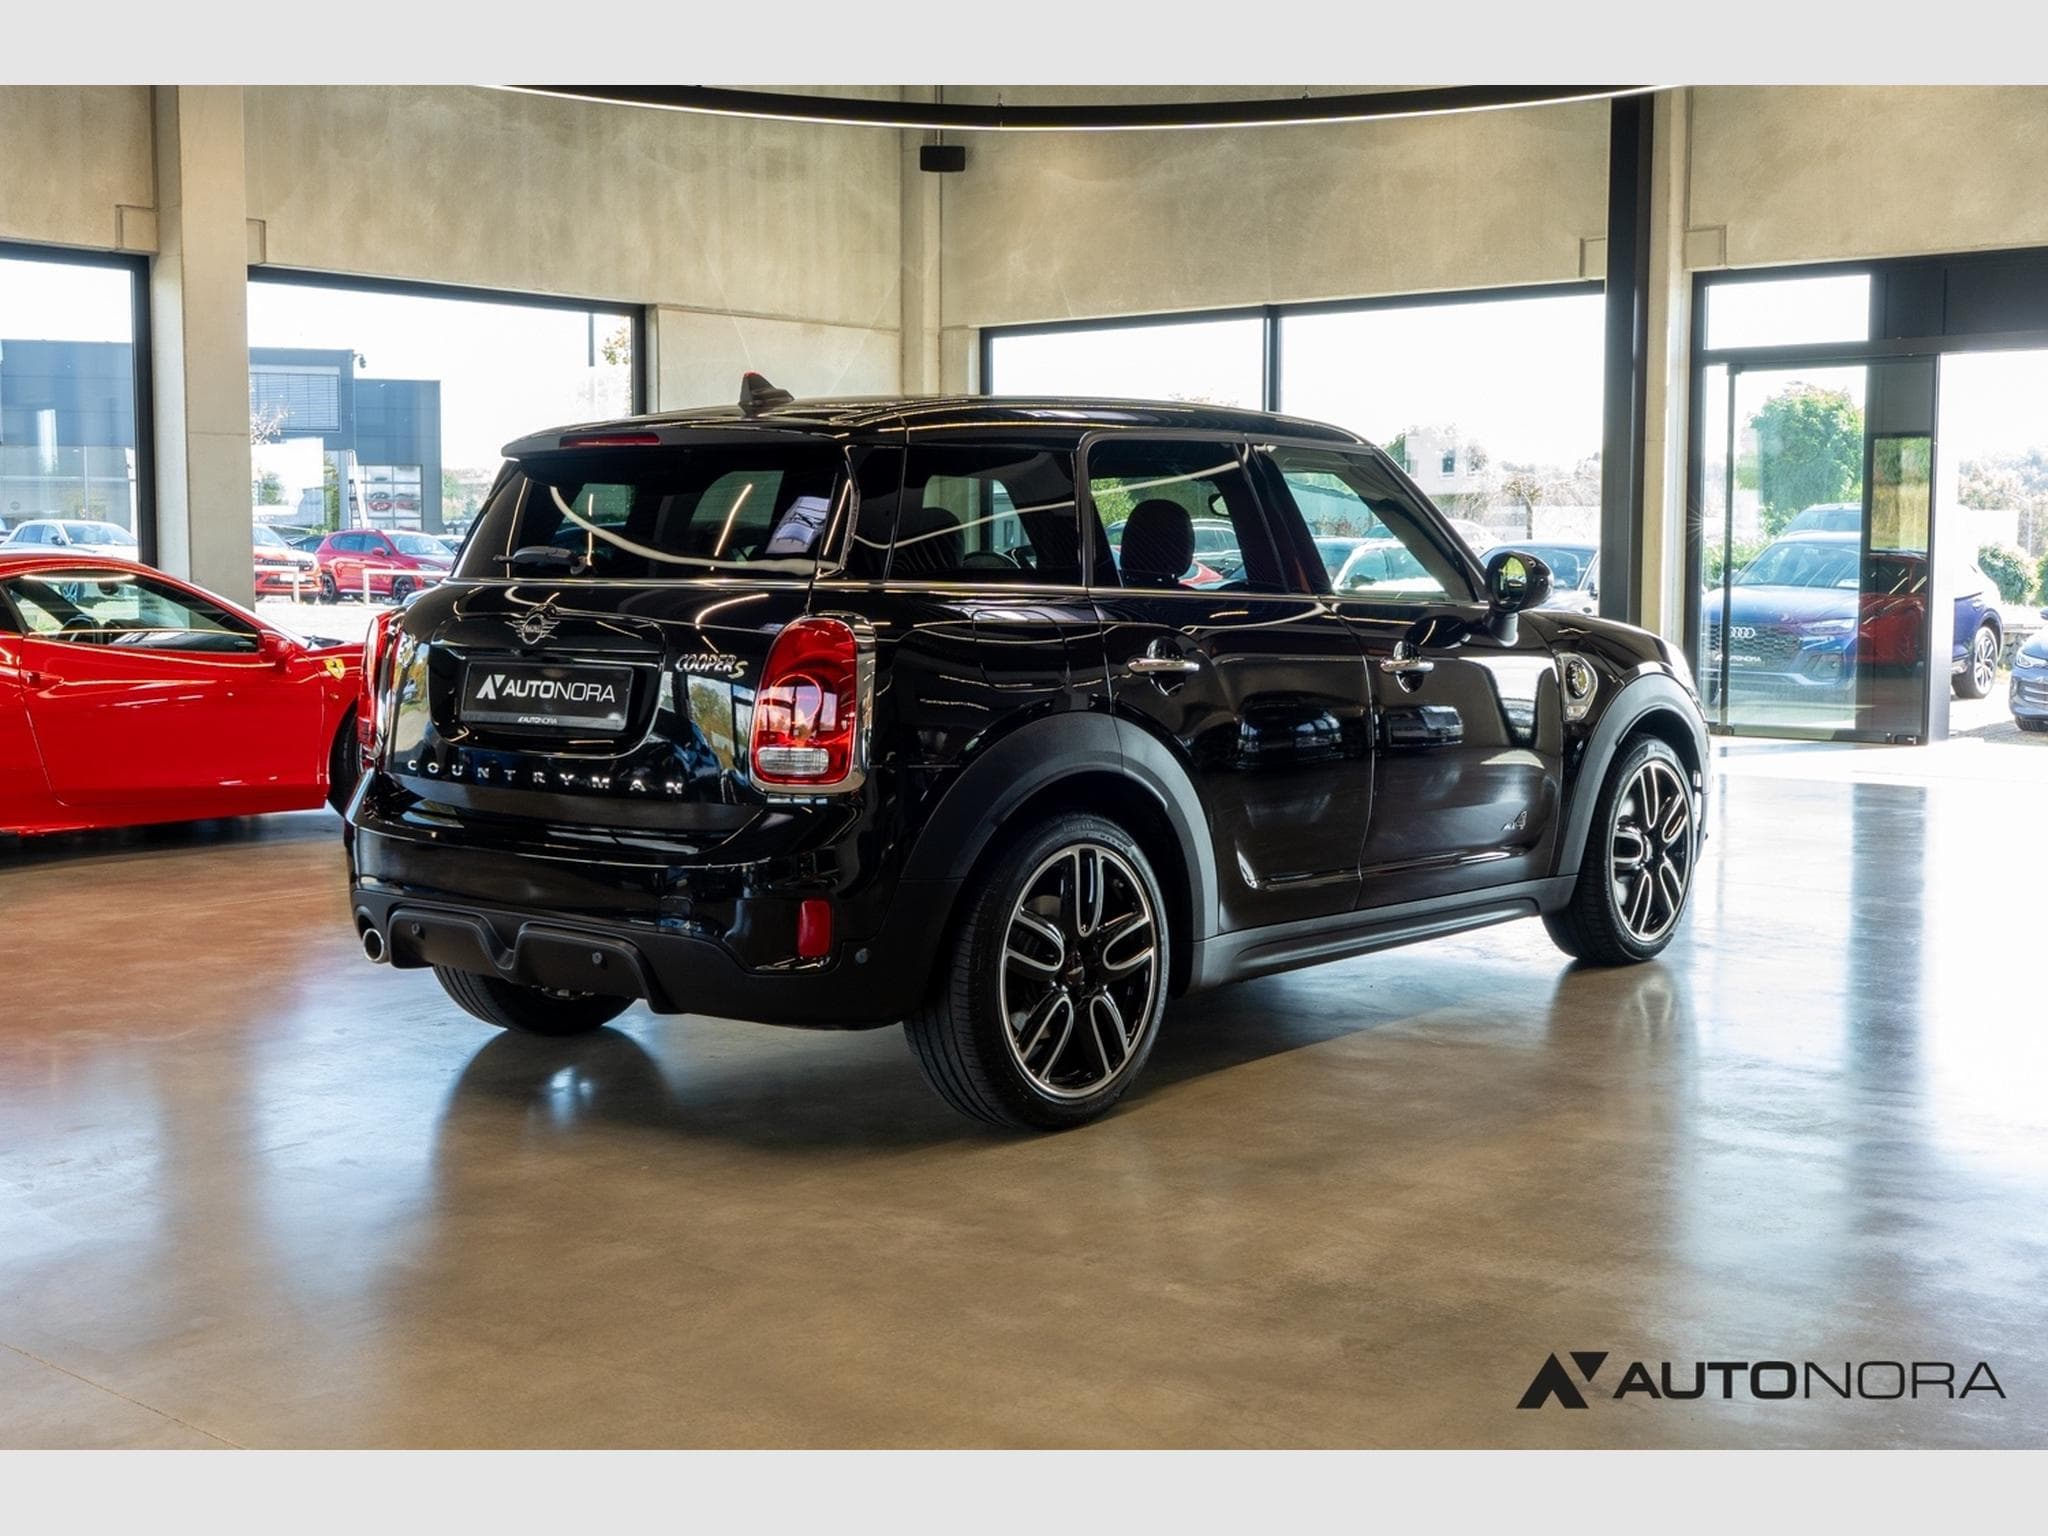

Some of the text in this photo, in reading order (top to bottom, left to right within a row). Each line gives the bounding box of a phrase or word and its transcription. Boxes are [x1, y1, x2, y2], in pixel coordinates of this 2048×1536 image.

[675, 653, 749, 679] COOPER S
[502, 679, 616, 703] AUTONORA
[407, 758, 684, 795] COUNTRYMAN
